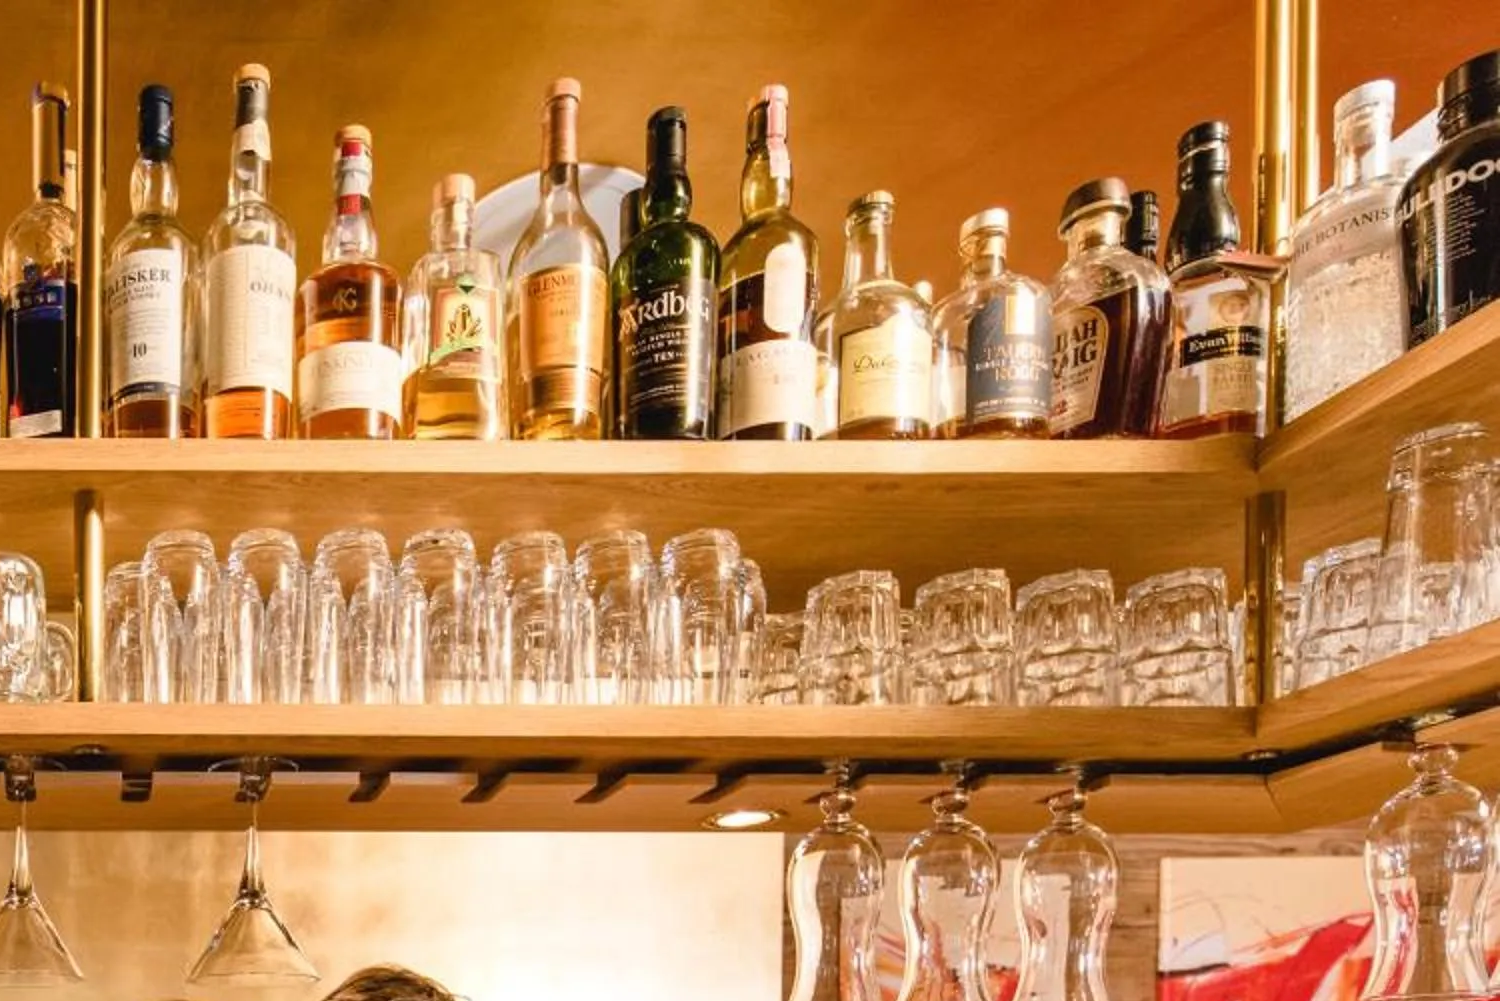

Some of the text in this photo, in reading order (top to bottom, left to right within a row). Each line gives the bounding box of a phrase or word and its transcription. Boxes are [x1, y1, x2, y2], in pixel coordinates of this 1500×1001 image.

[1395, 157, 1500, 227] BULLDO
[1315, 207, 1393, 244] BOTANIS
[132, 342, 148, 358] 10
